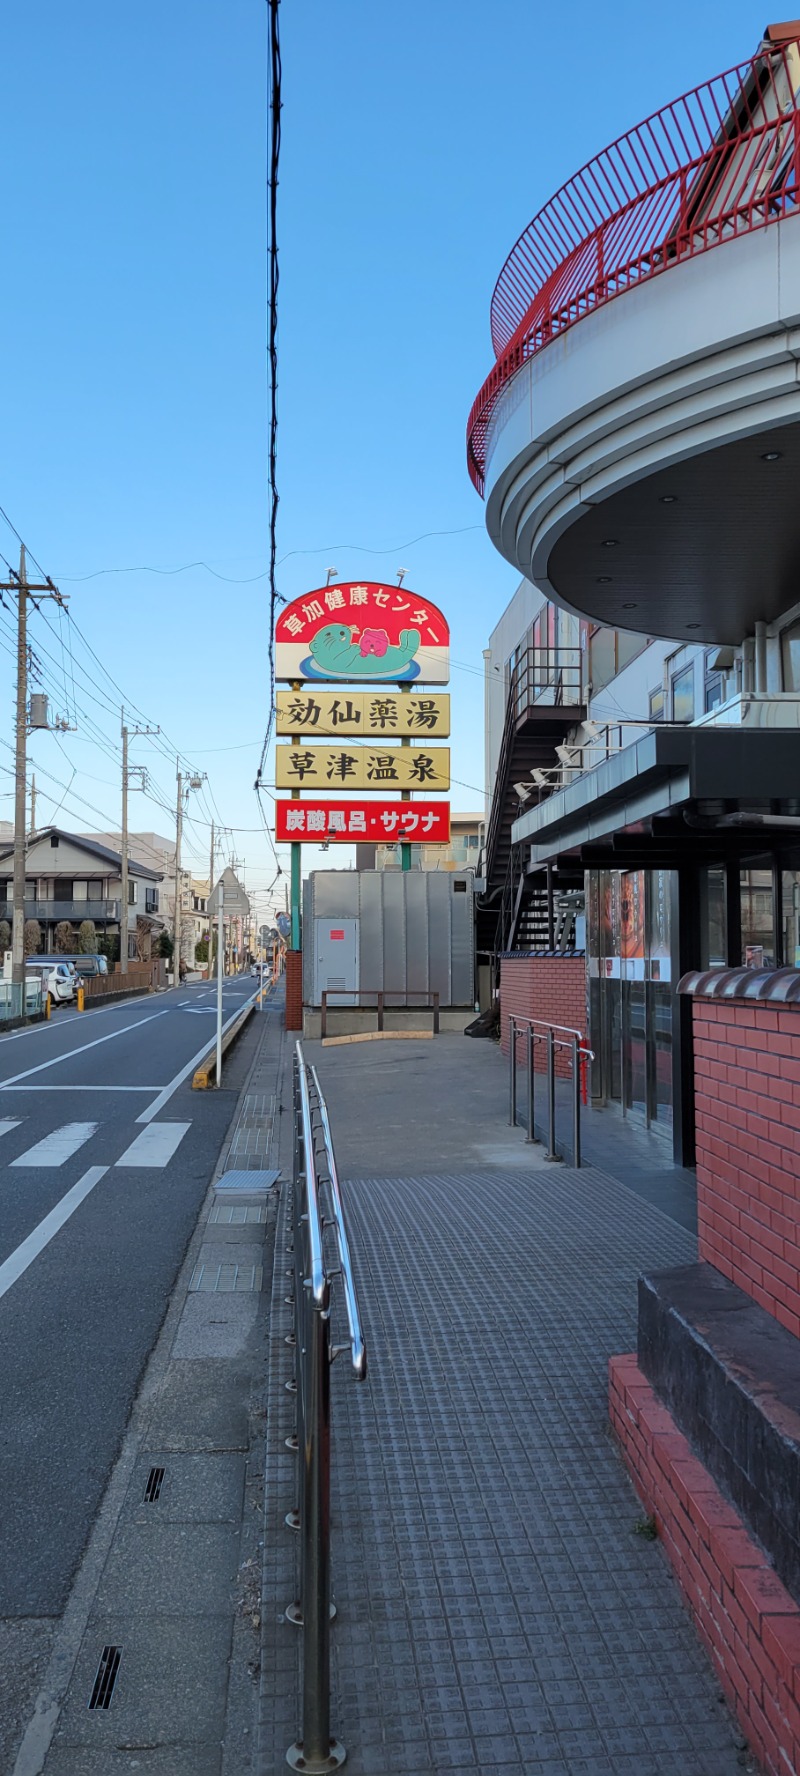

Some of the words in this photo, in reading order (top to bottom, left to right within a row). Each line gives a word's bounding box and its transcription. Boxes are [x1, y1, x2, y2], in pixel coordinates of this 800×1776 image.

[283, 586, 440, 643] 草加健康センター
[287, 698, 440, 729] 効仙薬湯
[286, 752, 439, 782] 草津温泉
[286, 809, 440, 832] 炭酸風呂・サウナ
